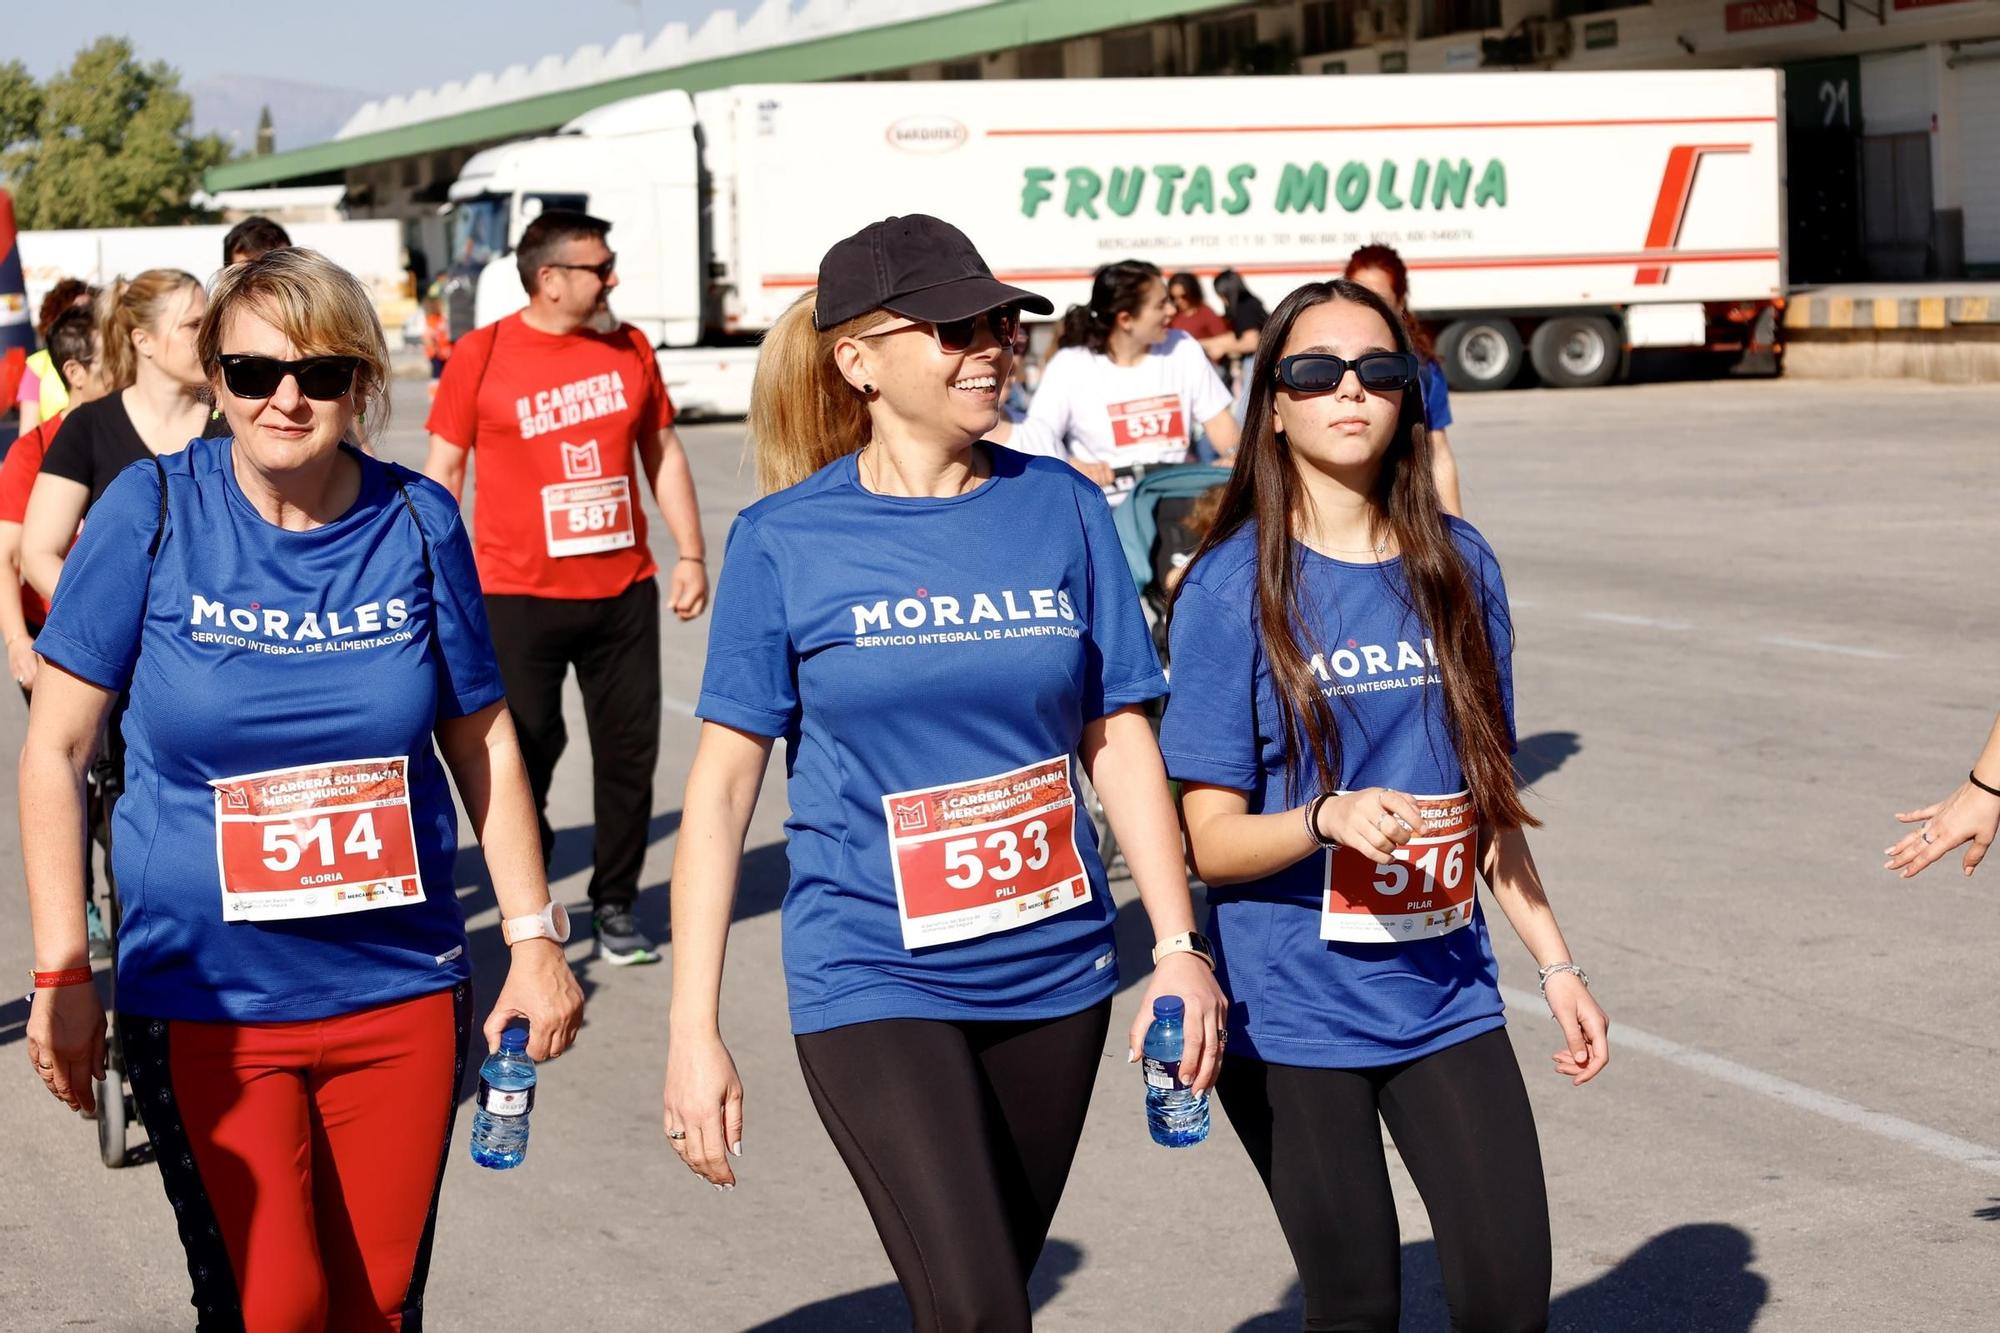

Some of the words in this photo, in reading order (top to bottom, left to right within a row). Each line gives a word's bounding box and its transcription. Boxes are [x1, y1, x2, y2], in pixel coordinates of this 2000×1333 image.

[1020, 163, 1256, 220] FRUTAS
[1274, 157, 1507, 214] MOLINA
[516, 396, 531, 419] II
[535, 369, 625, 414] CARRERA
[520, 391, 629, 440] SOLIDARIA
[1126, 412, 1173, 439] 537
[568, 502, 618, 533] 587
[190, 594, 409, 641] MORALES
[851, 588, 1075, 635] MORALES
[191, 631, 246, 648] SERVICIO
[247, 639, 304, 655] INTEGRAL
[306, 642, 323, 653] DE
[325, 630, 413, 652] ALIMENTACIÓN
[855, 634, 916, 648] SERVICIO
[918, 631, 981, 645] INTEGRAL
[984, 628, 1002, 640] DE
[1004, 624, 1080, 640] ALIMENTACIÓN
[1308, 638, 1440, 682] MORAL
[1356, 677, 1409, 693] INTEGRAL
[1410, 675, 1425, 687] DE
[263, 786, 358, 807] MERCAMURCIA
[269, 776, 333, 795] CARRERA
[334, 769, 400, 784] SOLIDARIA
[950, 788, 1011, 809] CARRERA
[1012, 770, 1064, 794] SOLIDARIA
[943, 793, 1033, 821] MERCAMURCIA
[1420, 808, 1449, 818] RERA
[262, 812, 383, 872] 514
[944, 820, 1050, 890] 533
[300, 871, 344, 886] GLORIA
[1373, 842, 1465, 896] 516
[996, 885, 1017, 898] PILI
[1407, 900, 1433, 910] PILAR
